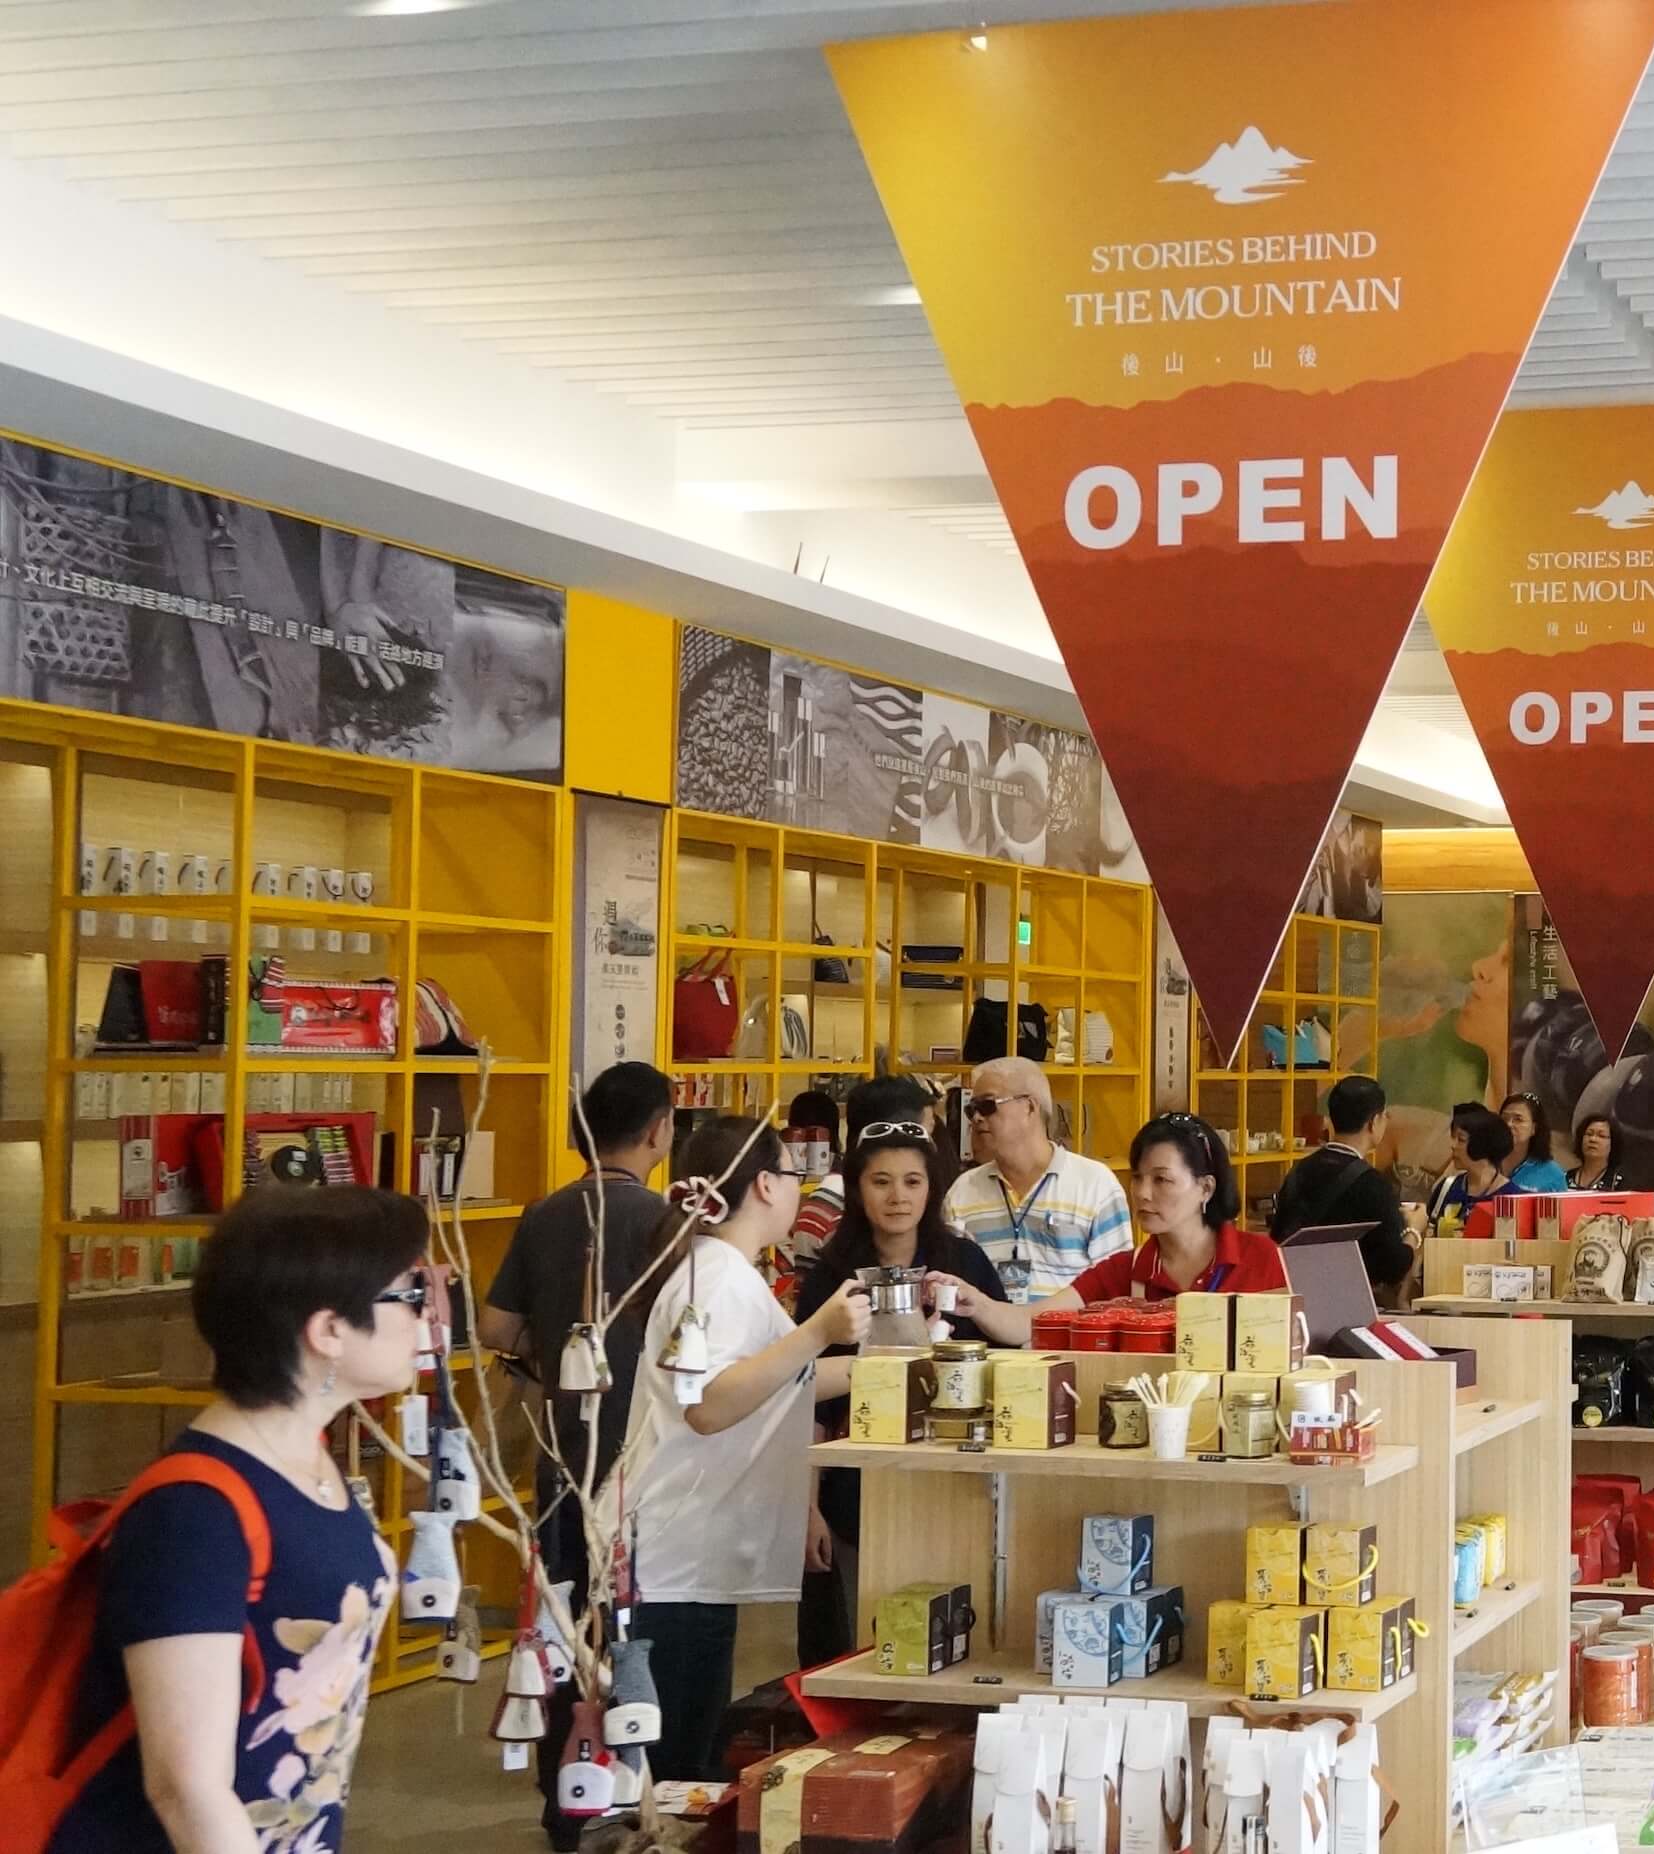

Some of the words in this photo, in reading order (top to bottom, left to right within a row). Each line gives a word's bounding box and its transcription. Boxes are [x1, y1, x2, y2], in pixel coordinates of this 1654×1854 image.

[1091, 239, 1234, 273] STORIES
[1239, 231, 1377, 265] BEHIND
[1065, 288, 1153, 327] THE
[1160, 276, 1402, 322] MOUNTAIN
[1064, 454, 1399, 550] OPEN
[1526, 550, 1621, 571] STORIES
[1510, 580, 1568, 604] THE
